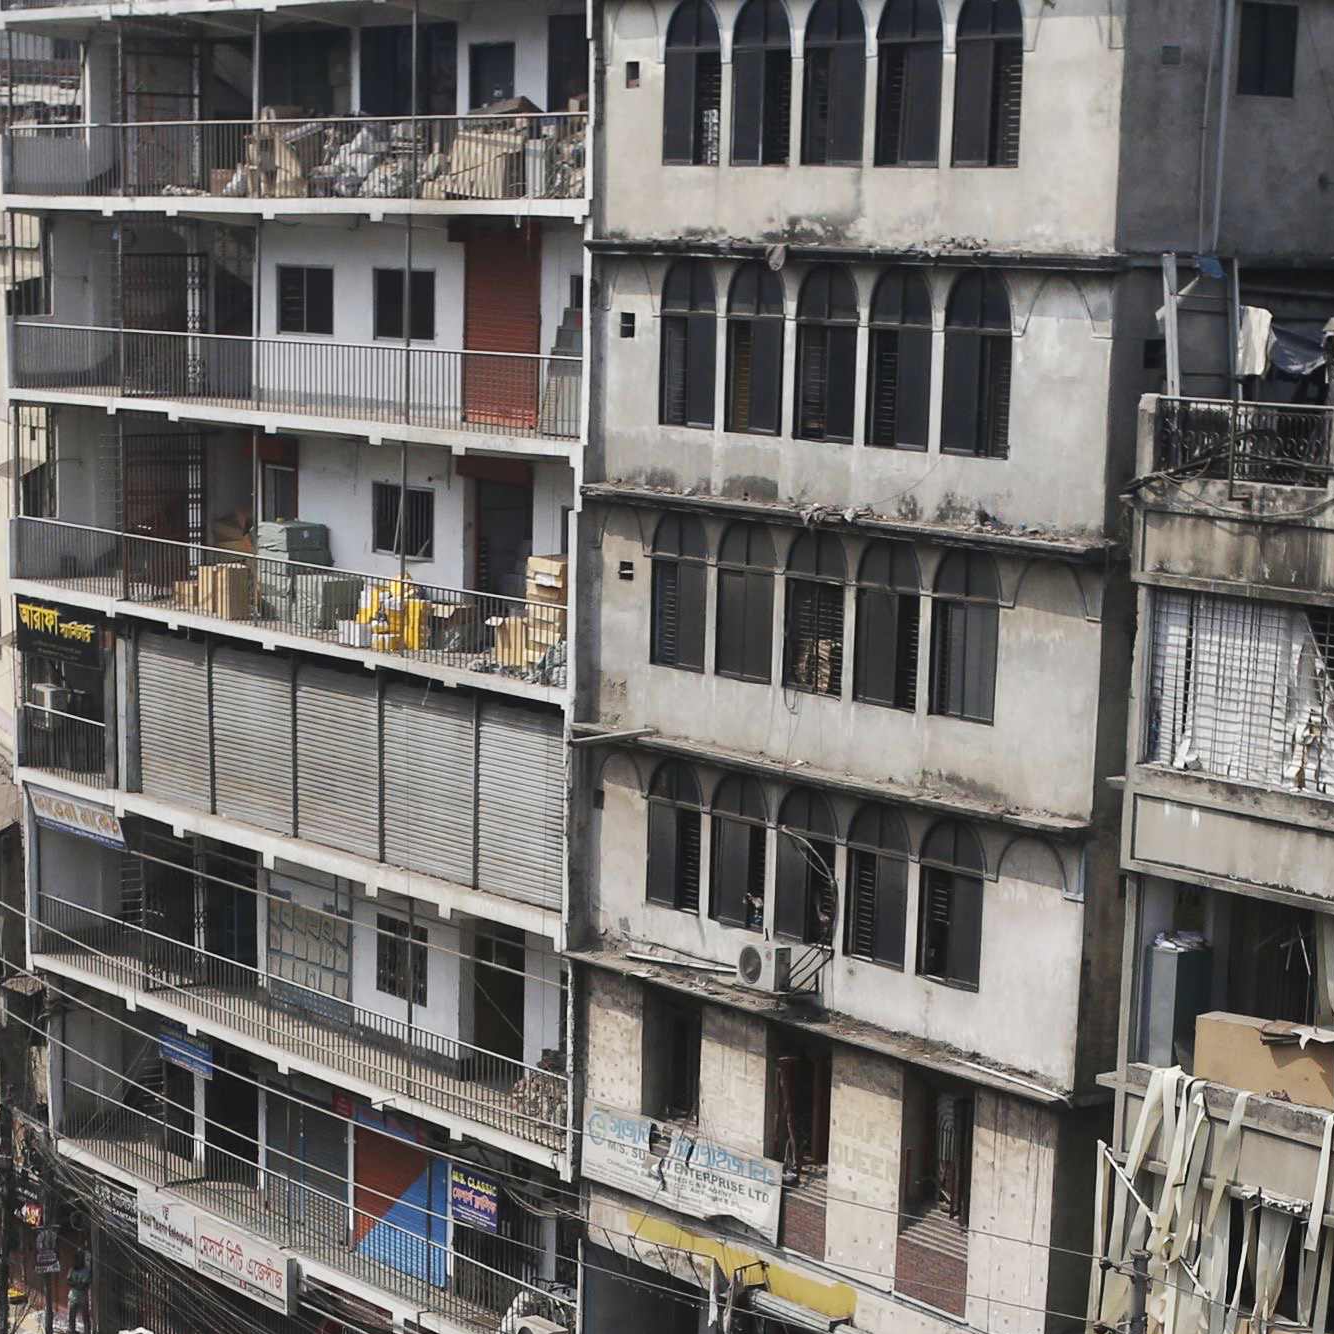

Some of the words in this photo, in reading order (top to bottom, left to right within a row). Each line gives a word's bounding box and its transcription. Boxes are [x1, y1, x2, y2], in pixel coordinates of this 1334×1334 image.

[18, 603, 59, 636] আরাফা
[674, 1162, 744, 1196] ENTERPRISE
[225, 1240, 244, 1272] সিটি
